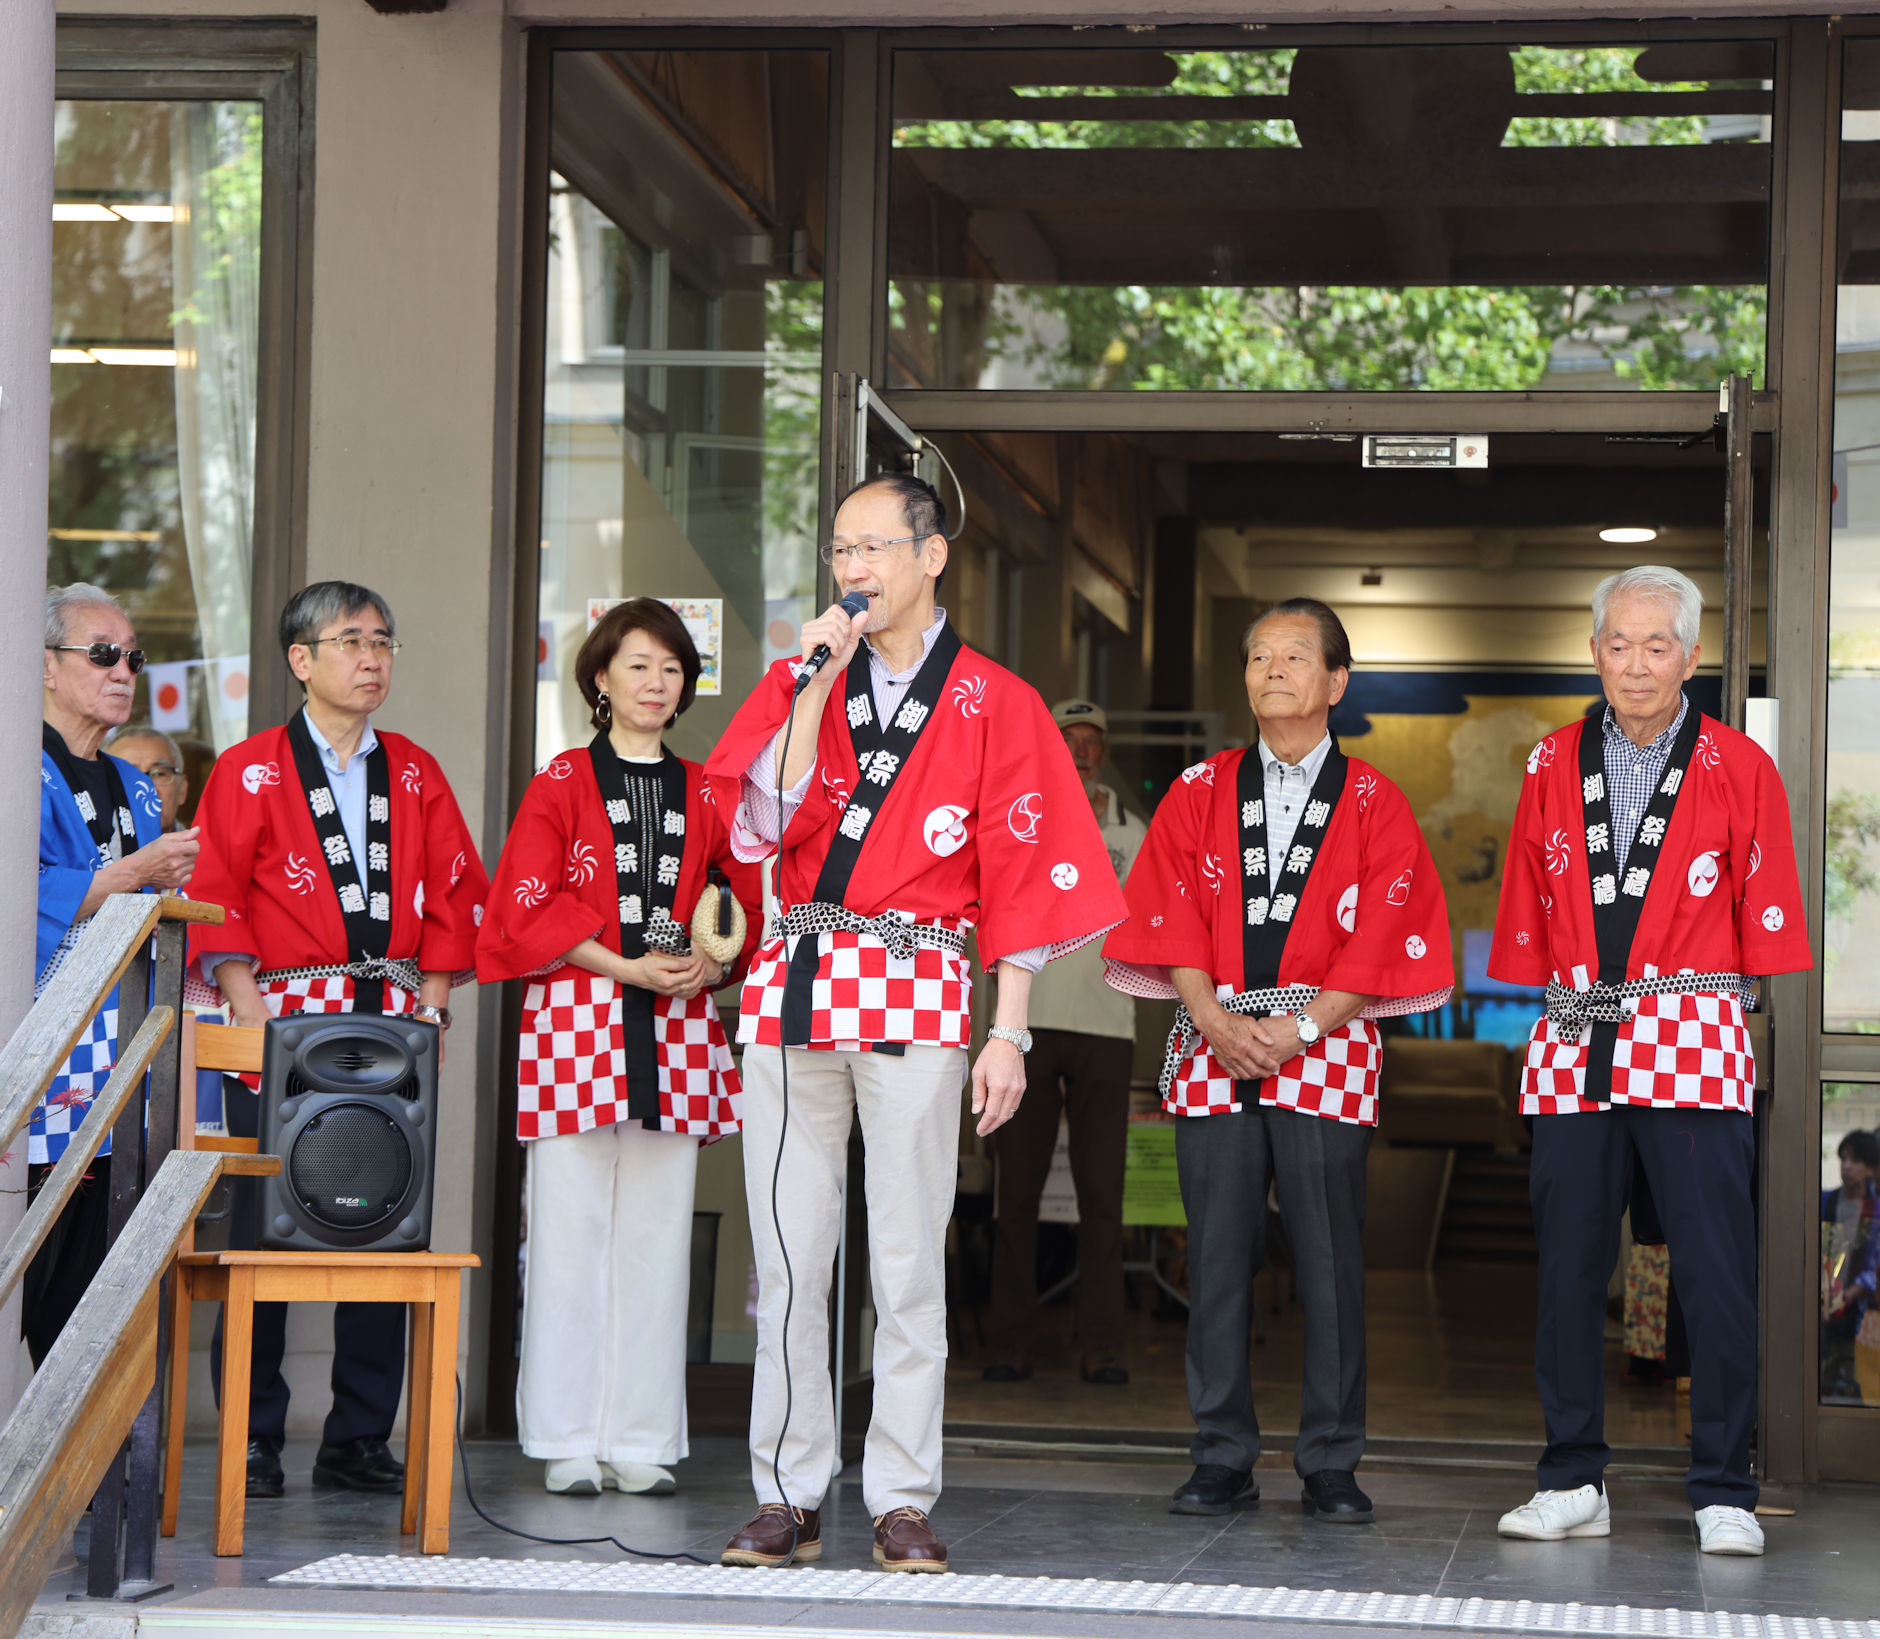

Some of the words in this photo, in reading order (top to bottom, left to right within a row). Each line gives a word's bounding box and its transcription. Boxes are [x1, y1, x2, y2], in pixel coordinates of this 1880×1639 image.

[309, 786, 367, 914] 御祭禮
[368, 794, 390, 922] 御祭禮
[606, 799, 643, 925] 御祭禮
[1242, 799, 1269, 926] 御祭禮
[1269, 799, 1330, 923] 御祭禮
[1583, 772, 1617, 906] 御祭禮
